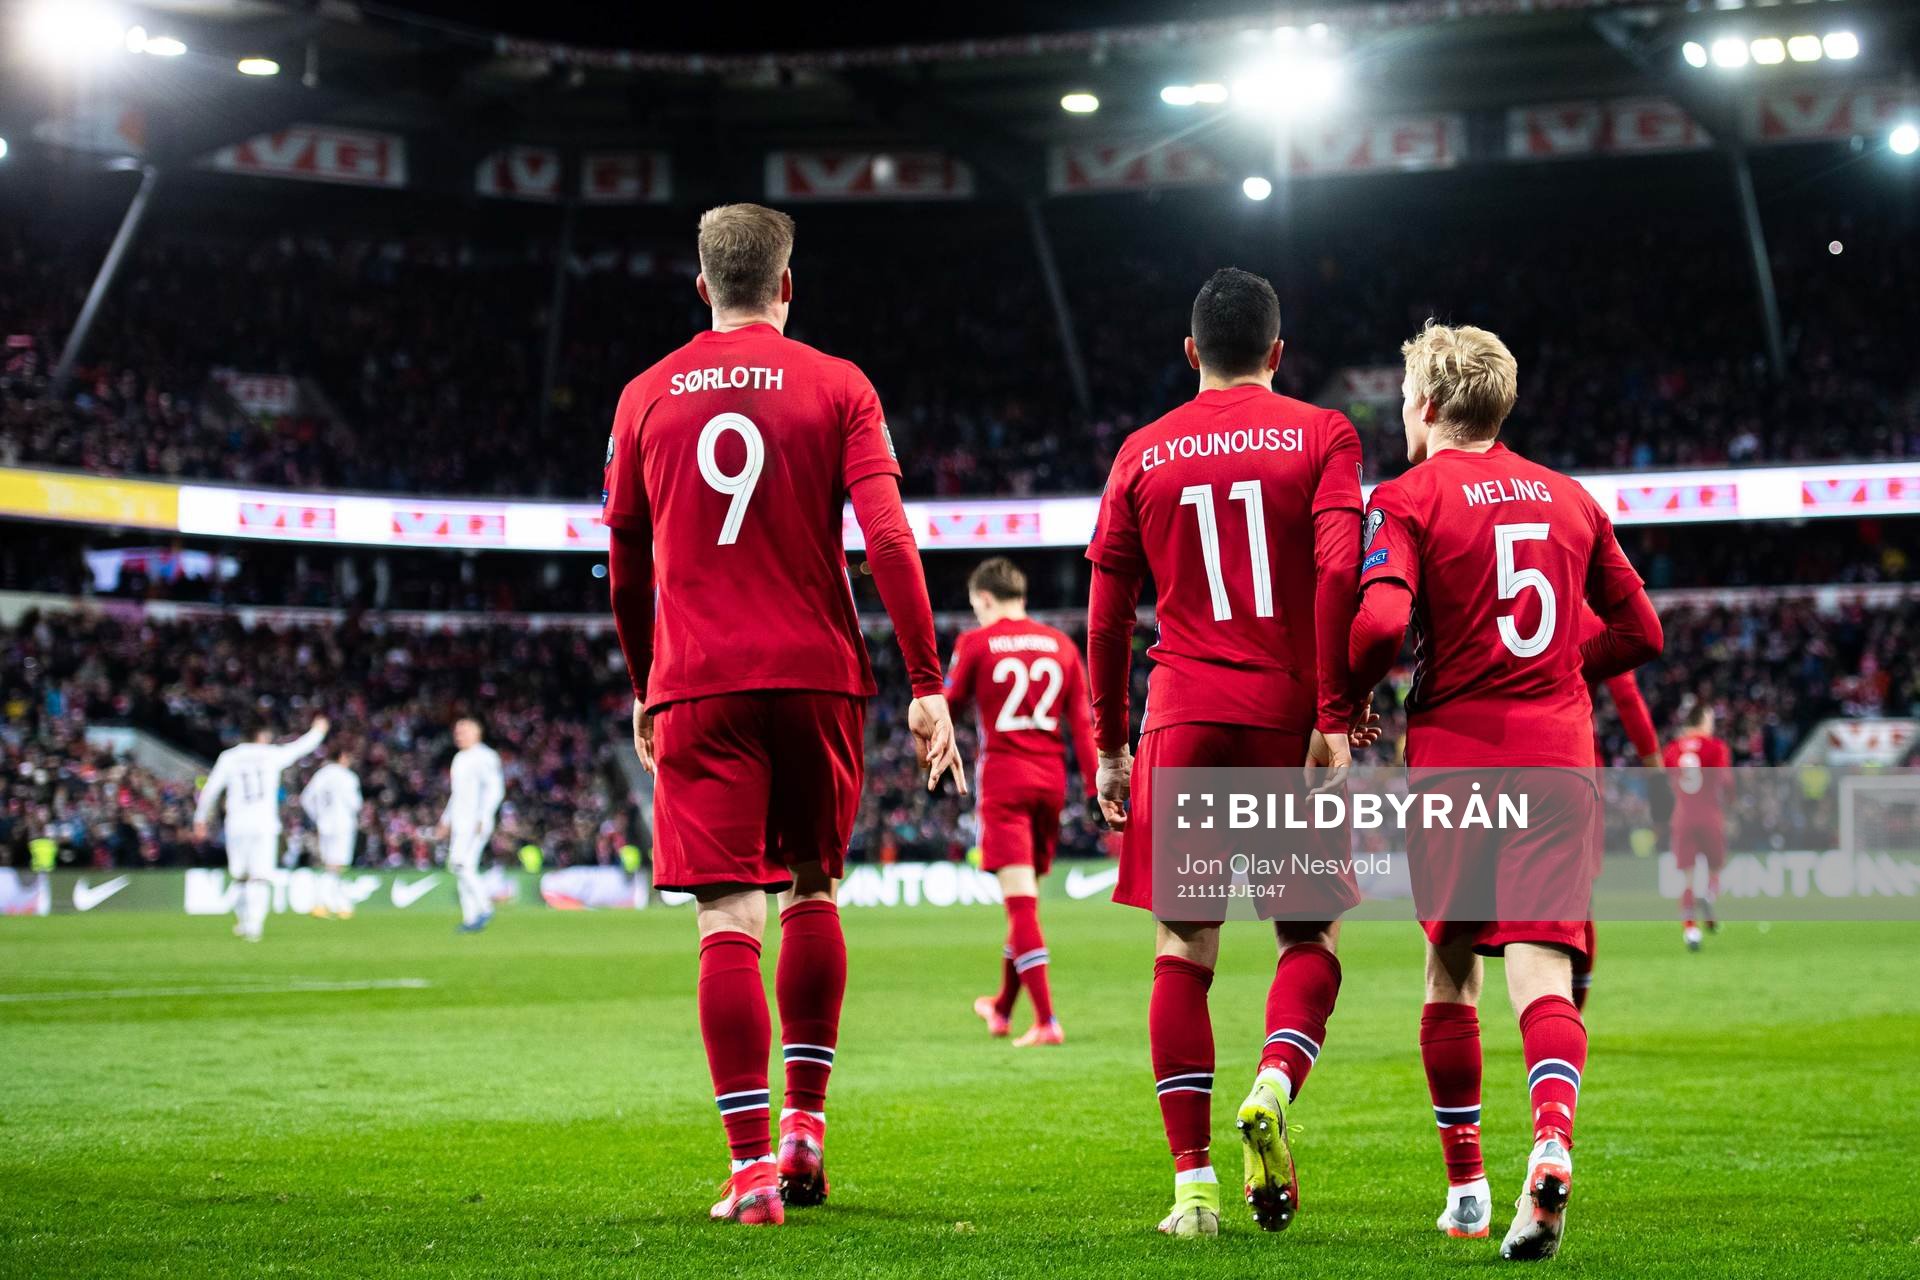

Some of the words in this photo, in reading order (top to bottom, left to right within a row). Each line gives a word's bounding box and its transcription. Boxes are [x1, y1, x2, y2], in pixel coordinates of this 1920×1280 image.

[669, 366, 784, 396] SØRLOTH
[697, 412, 765, 546] 9
[1461, 478, 1553, 507] MELING
[1179, 479, 1274, 622] 11
[1494, 522, 1557, 658] 5
[992, 656, 1065, 733] 22
